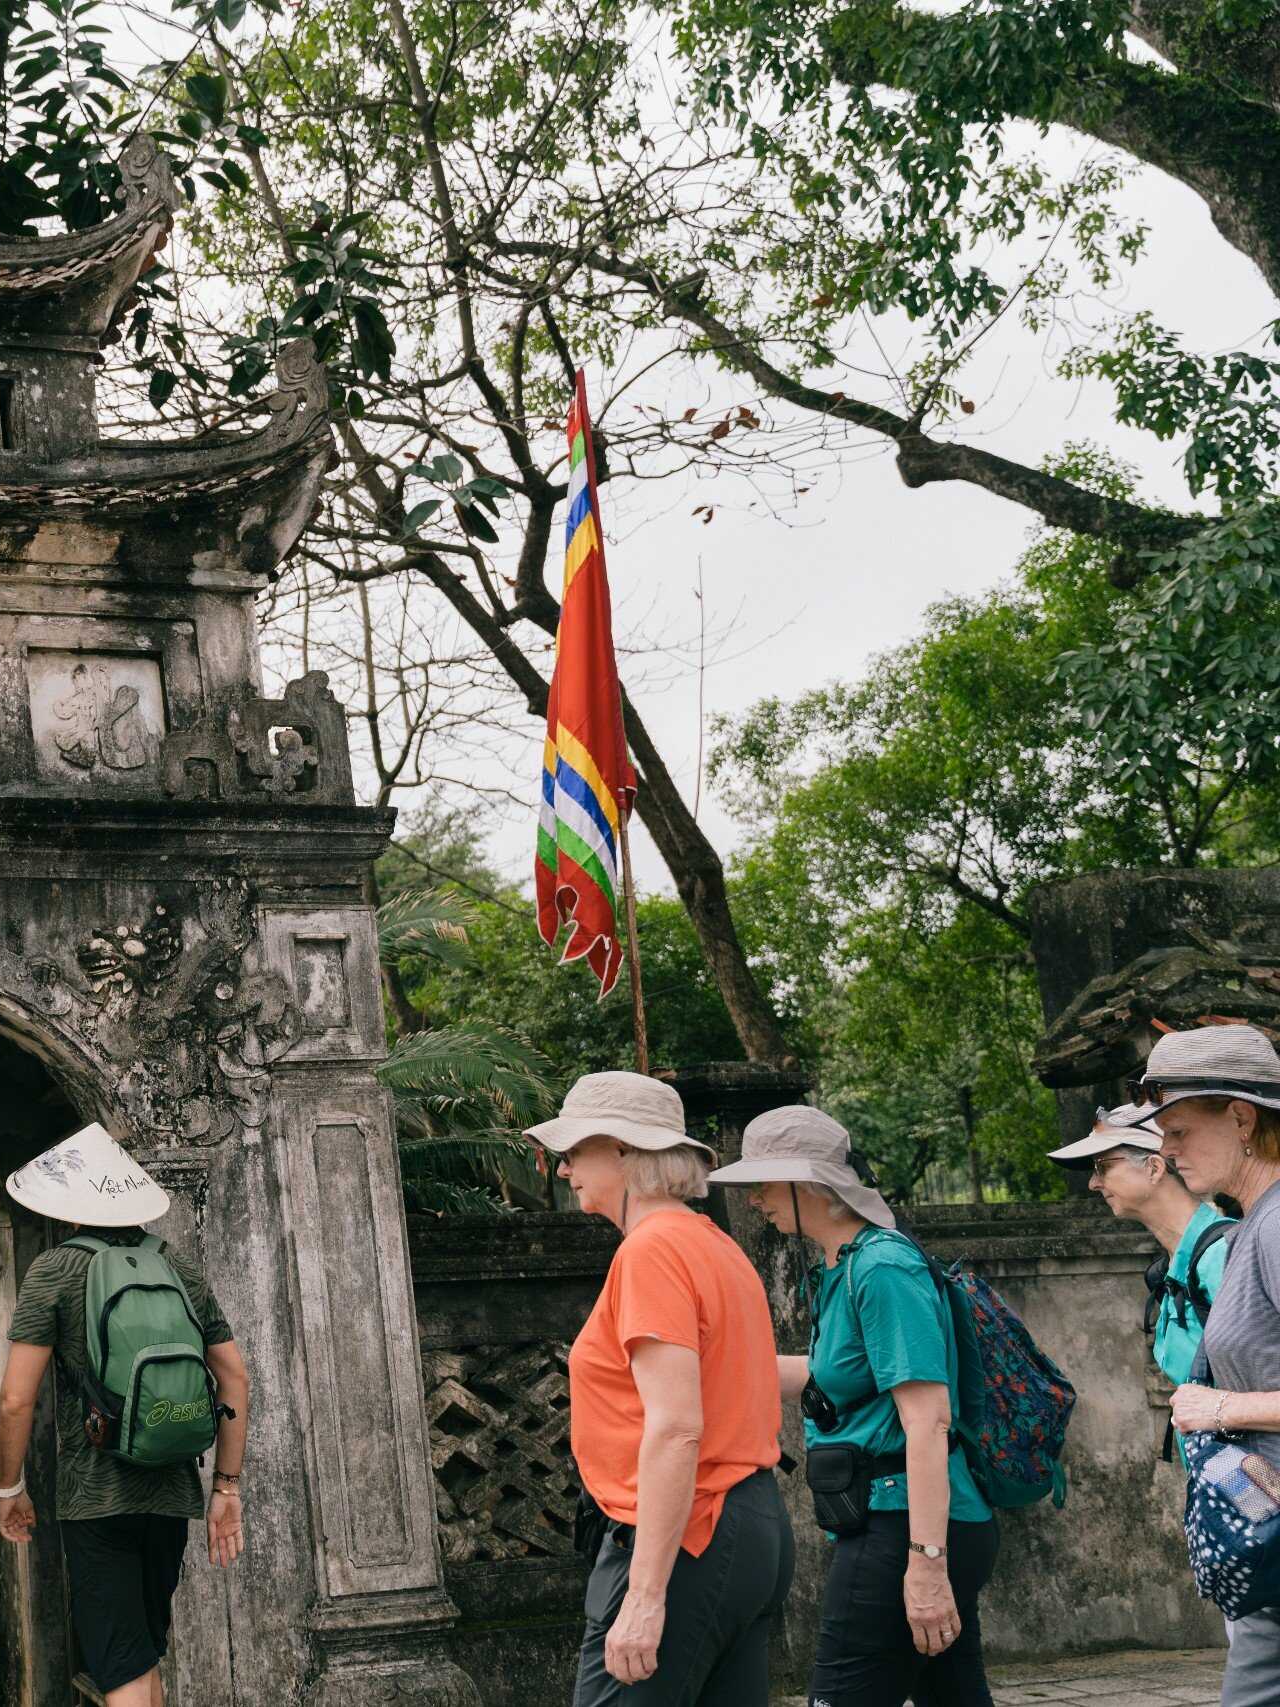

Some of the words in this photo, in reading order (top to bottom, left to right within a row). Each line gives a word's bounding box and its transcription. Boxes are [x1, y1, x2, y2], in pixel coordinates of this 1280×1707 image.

[52, 663, 146, 770] 北
[89, 1175, 125, 1199] Việt
[169, 1398, 209, 1422] asics
